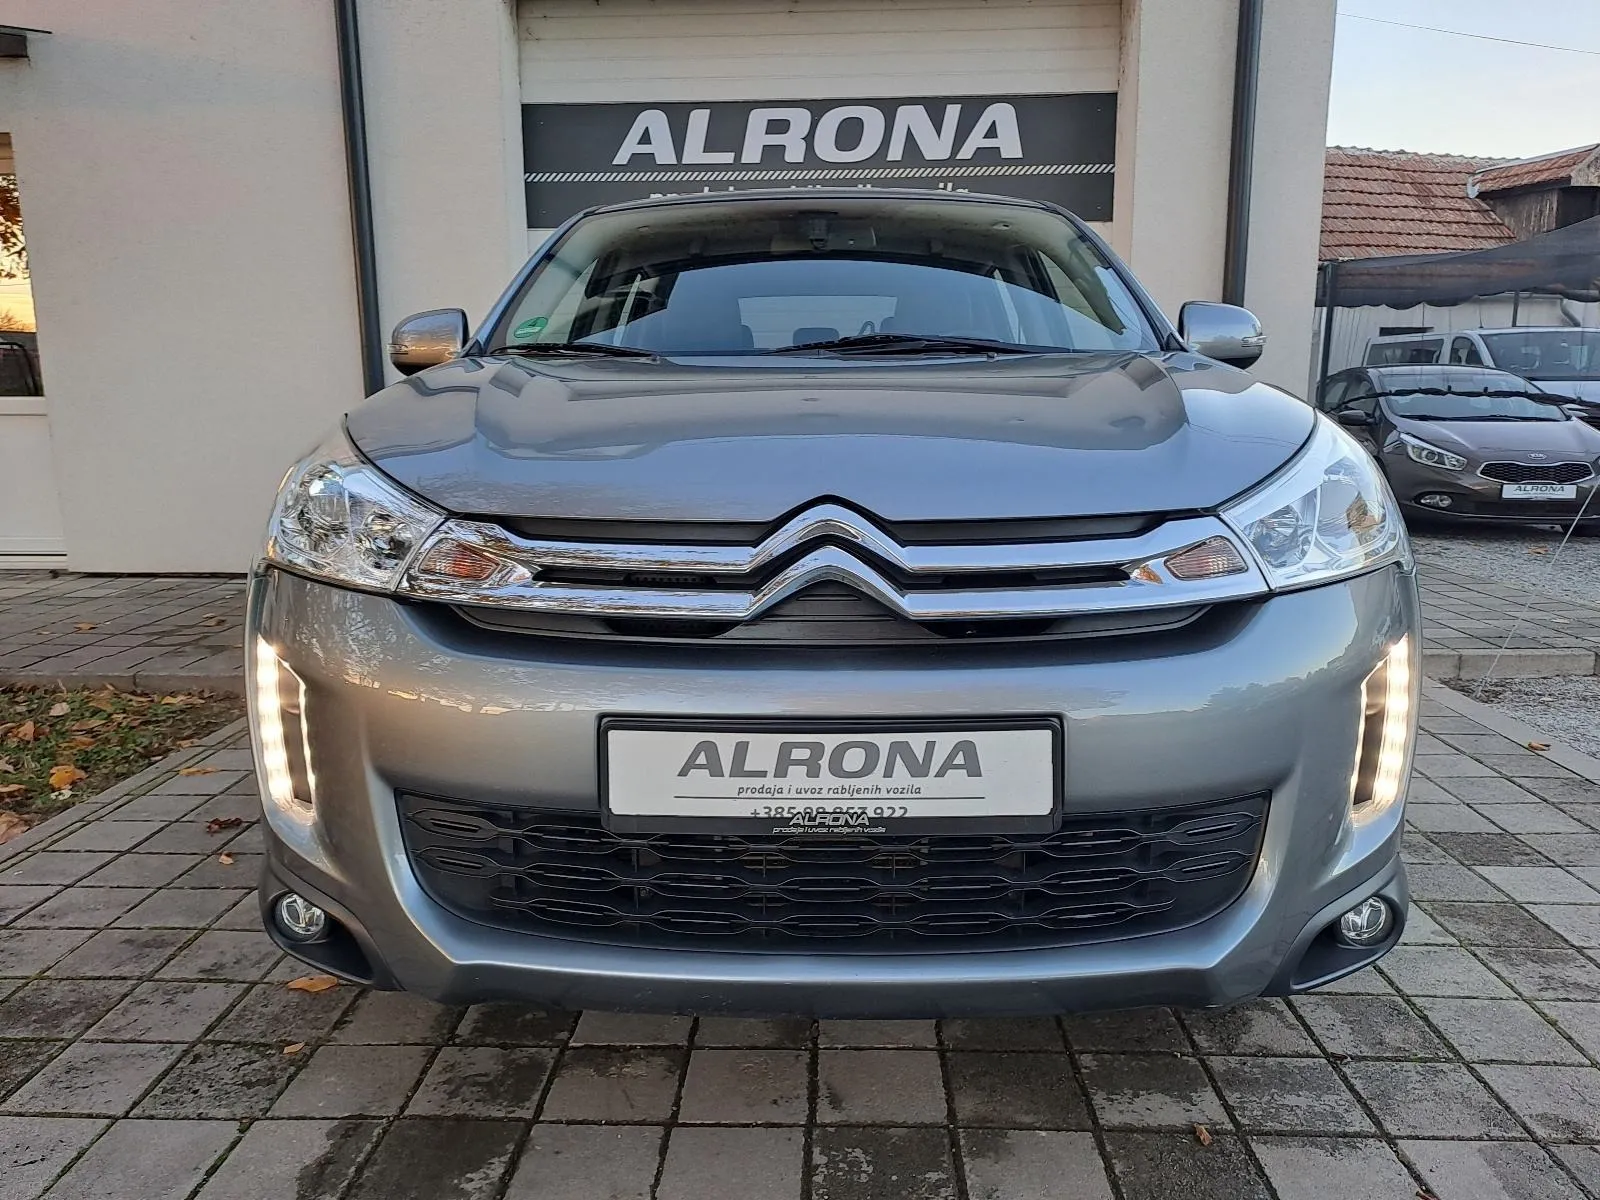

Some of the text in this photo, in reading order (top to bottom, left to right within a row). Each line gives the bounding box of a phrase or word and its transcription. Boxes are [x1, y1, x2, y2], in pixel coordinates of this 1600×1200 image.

[611, 102, 1024, 165] ALRONA
[677, 739, 982, 778] ALRONA
[737, 784, 922, 797] prodaja i uvoz rabljenih vozila
[788, 812, 870, 826] ALRONA
[772, 826, 804, 835] prodaja
[829, 826, 863, 835] rabljenih
